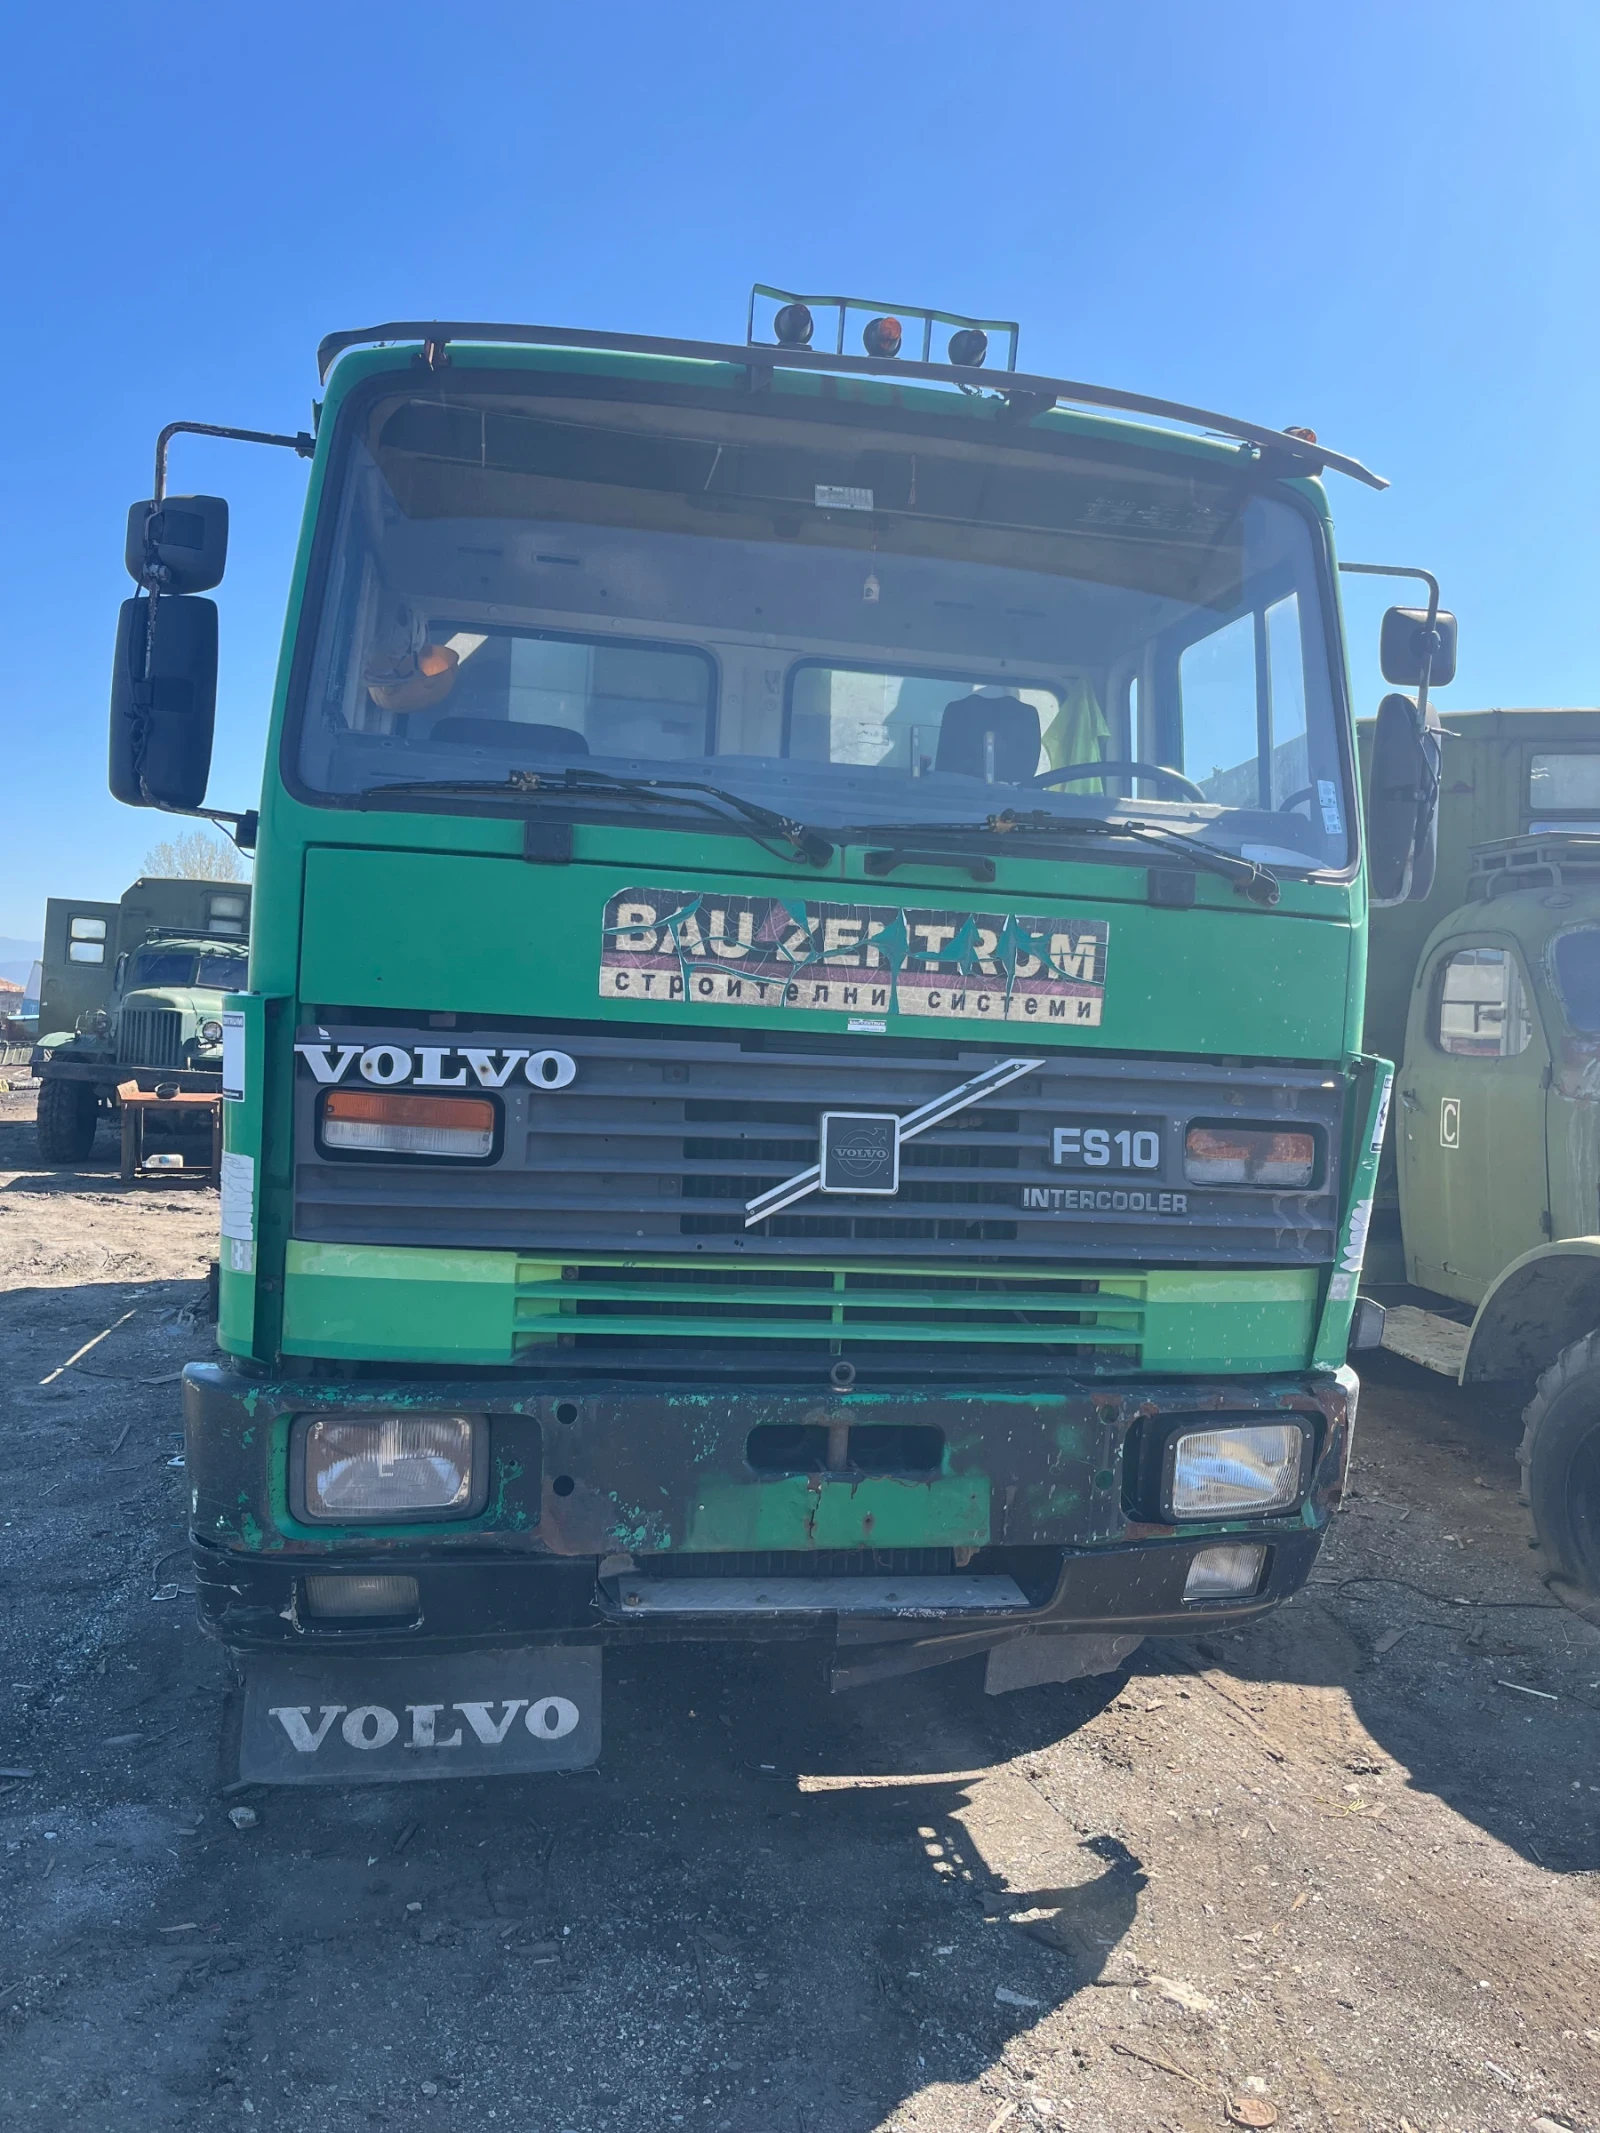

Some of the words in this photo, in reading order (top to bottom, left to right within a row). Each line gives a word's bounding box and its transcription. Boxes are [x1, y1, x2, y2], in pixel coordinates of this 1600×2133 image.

[615, 971, 886, 1008] строителни
[927, 990, 1092, 1019] системи
[294, 1044, 576, 1089] VOLVO
[834, 1148, 887, 1158] VOLVO
[1053, 1127, 1159, 1168] FS10
[1023, 1187, 1188, 1213] INTERCOOLER
[268, 1696, 580, 1752] VOLVO
